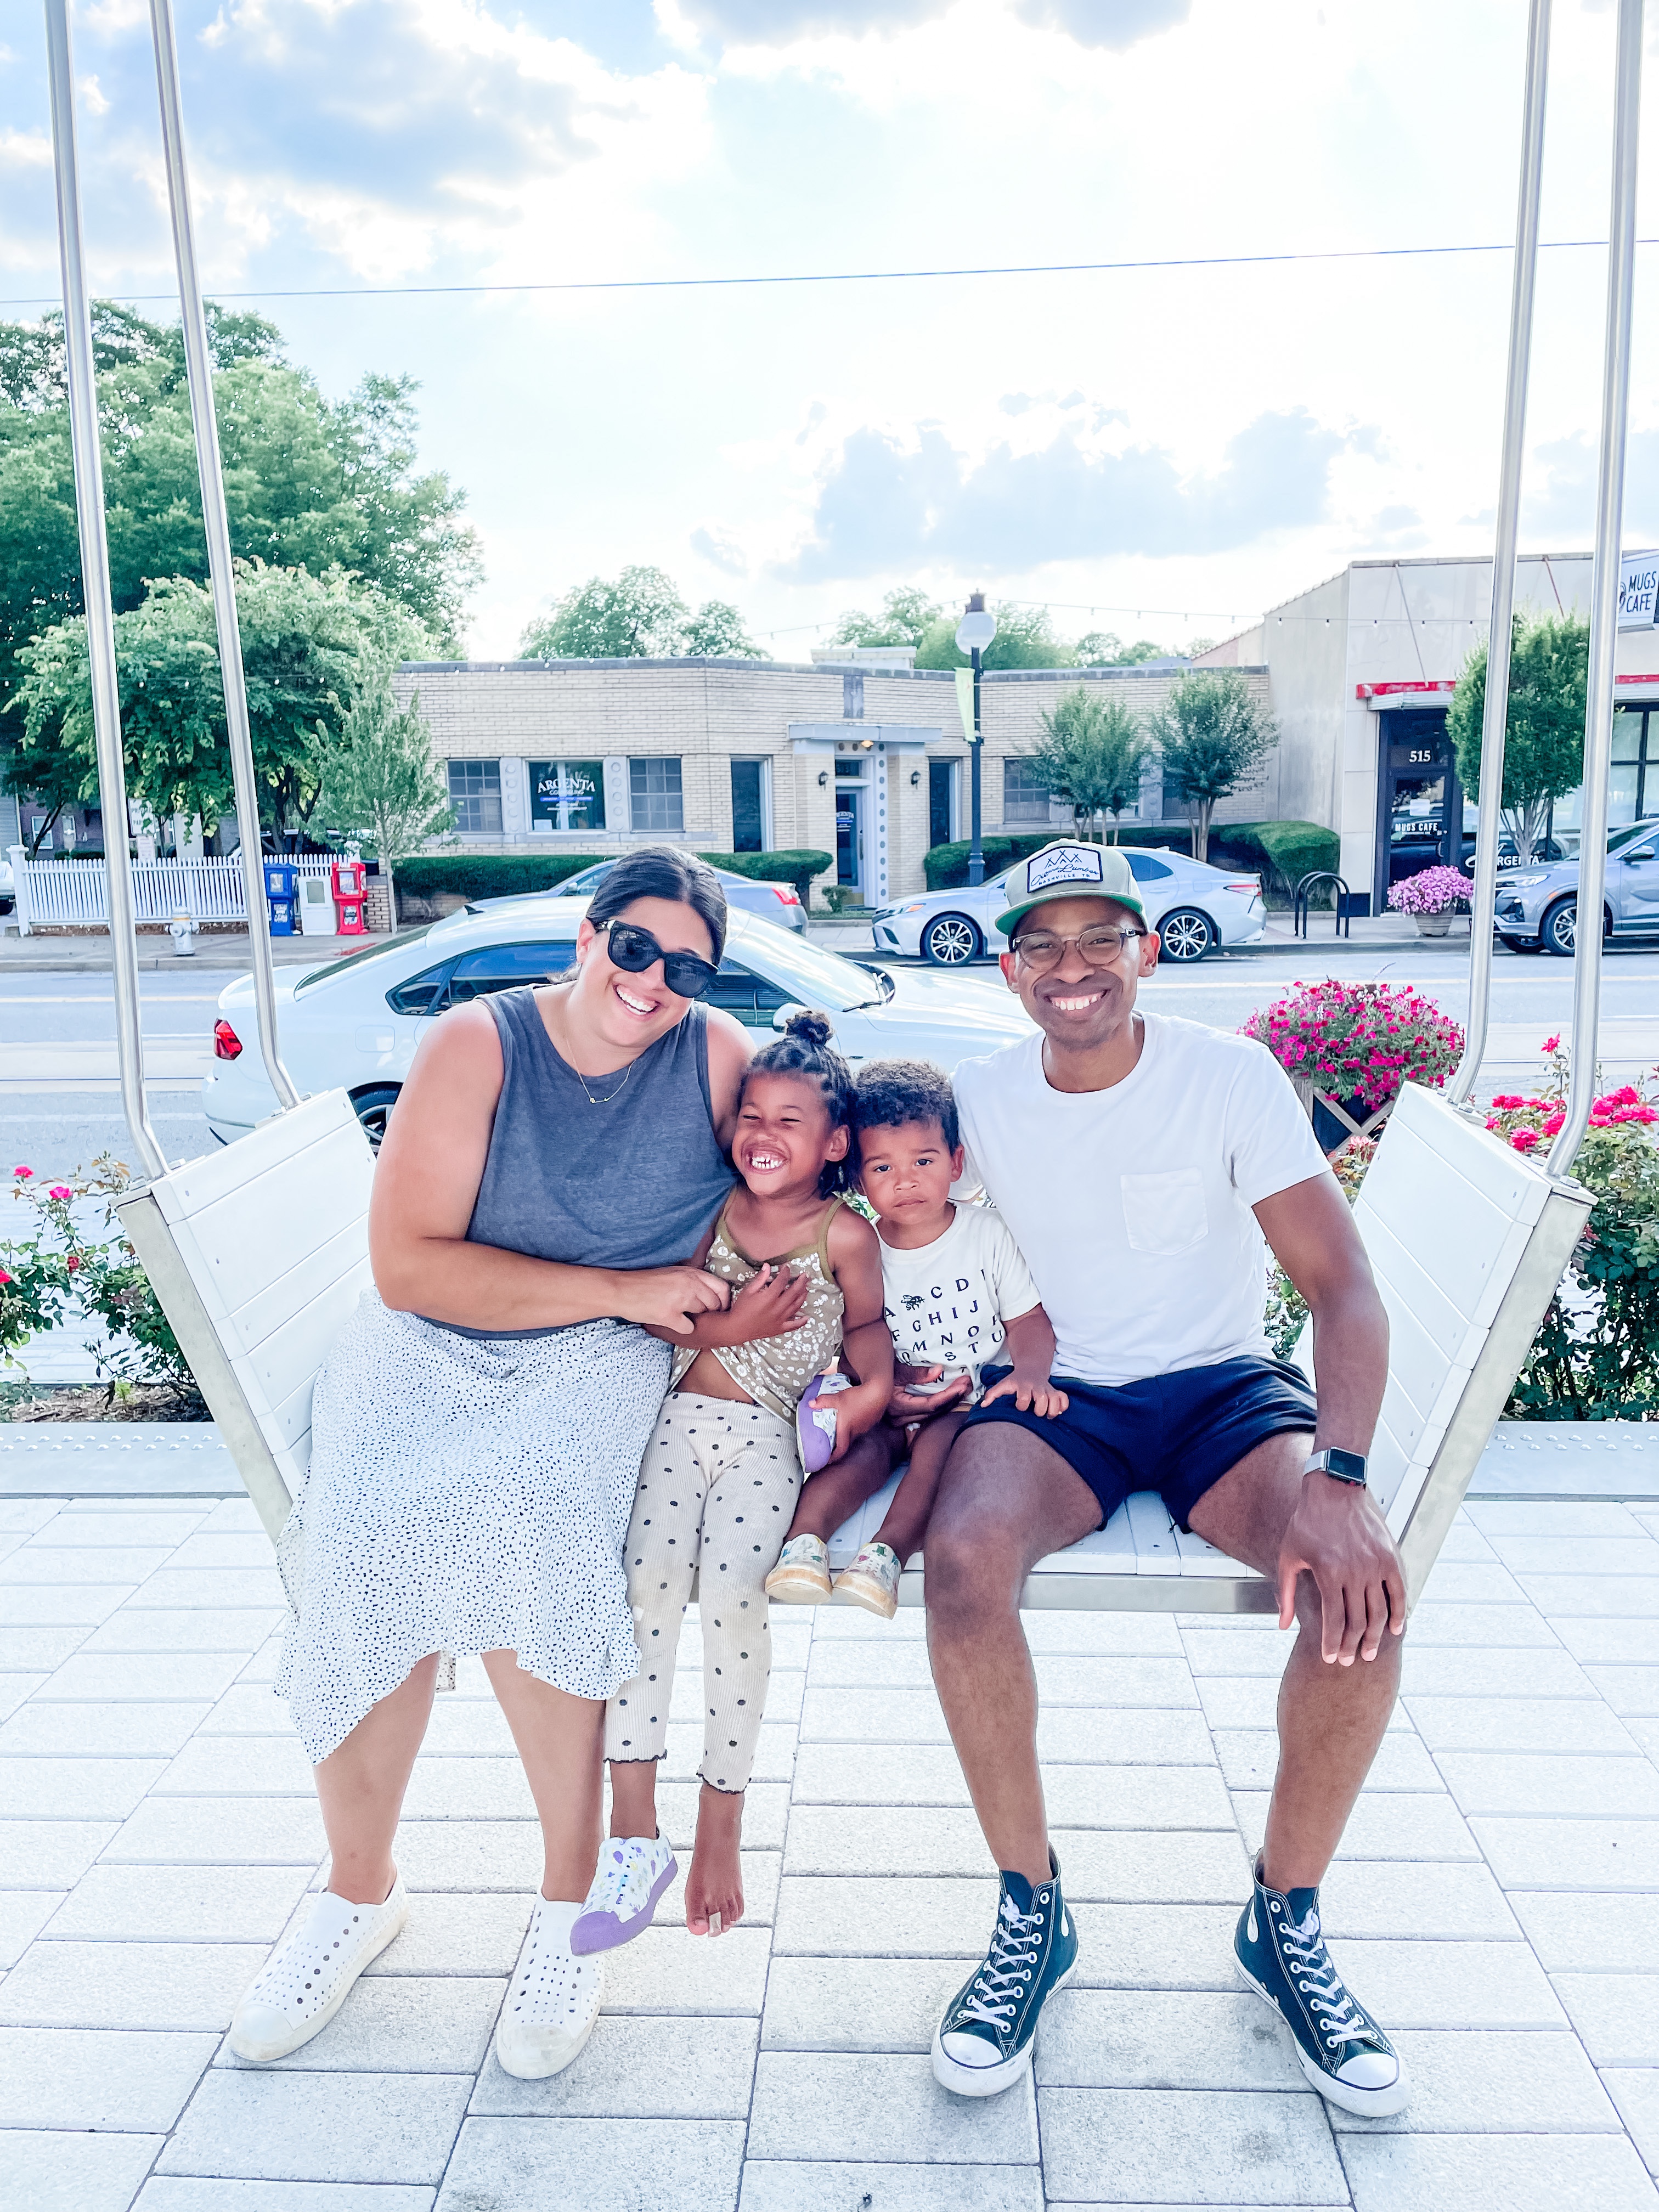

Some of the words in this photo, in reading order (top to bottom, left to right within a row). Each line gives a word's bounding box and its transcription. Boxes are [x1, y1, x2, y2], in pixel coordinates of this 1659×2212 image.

[1628, 571, 1657, 592] MUGS
[1626, 593, 1652, 613] CAFE
[1409, 750, 1431, 763] 515
[538, 778, 596, 793] ARGENTA
[1395, 823, 1416, 831] MUGS
[1418, 823, 1438, 831] CAFE
[930, 1286, 943, 1299] C
[955, 1278, 969, 1291] D
[928, 1311, 943, 1325] H
[951, 1307, 958, 1319] I
[969, 1300, 978, 1313] J
[912, 1340, 927, 1352] M
[940, 1333, 953, 1345] N
[968, 1325, 979, 1337] O
[945, 1352, 957, 1361] S
[968, 1341, 978, 1353] T
[991, 1330, 1002, 1342] U
